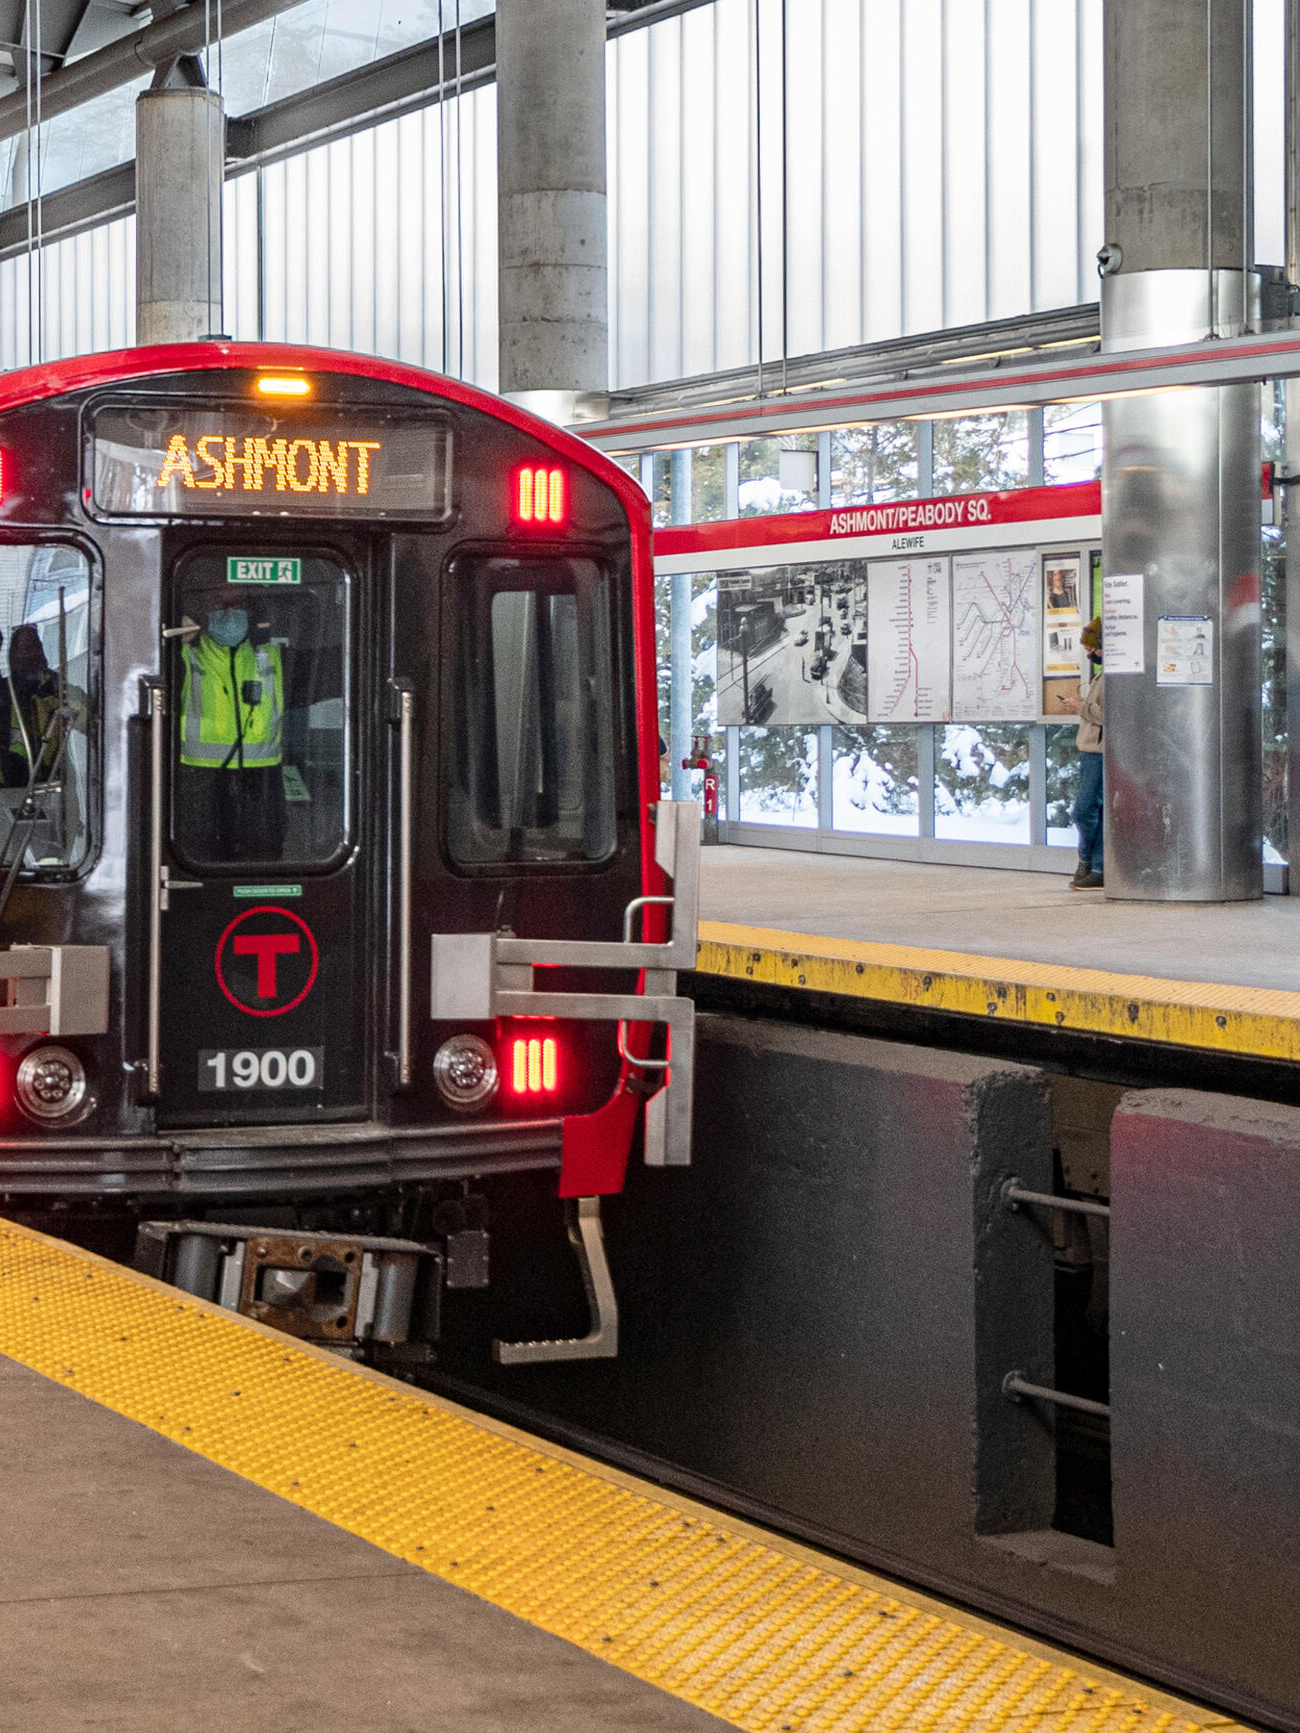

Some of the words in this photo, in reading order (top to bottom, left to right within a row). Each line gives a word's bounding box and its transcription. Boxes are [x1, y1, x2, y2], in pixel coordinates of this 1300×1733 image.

[156, 434, 381, 494] ASHMONT
[829, 501, 965, 535] ASHMONT/PEABODY
[967, 499, 992, 521] SQ.
[892, 536, 925, 550] ALEWIFE
[236, 561, 273, 580] EXIT
[705, 778, 715, 790] R
[706, 799, 713, 811] 1
[233, 933, 300, 998] T
[207, 1050, 316, 1089] 1900
